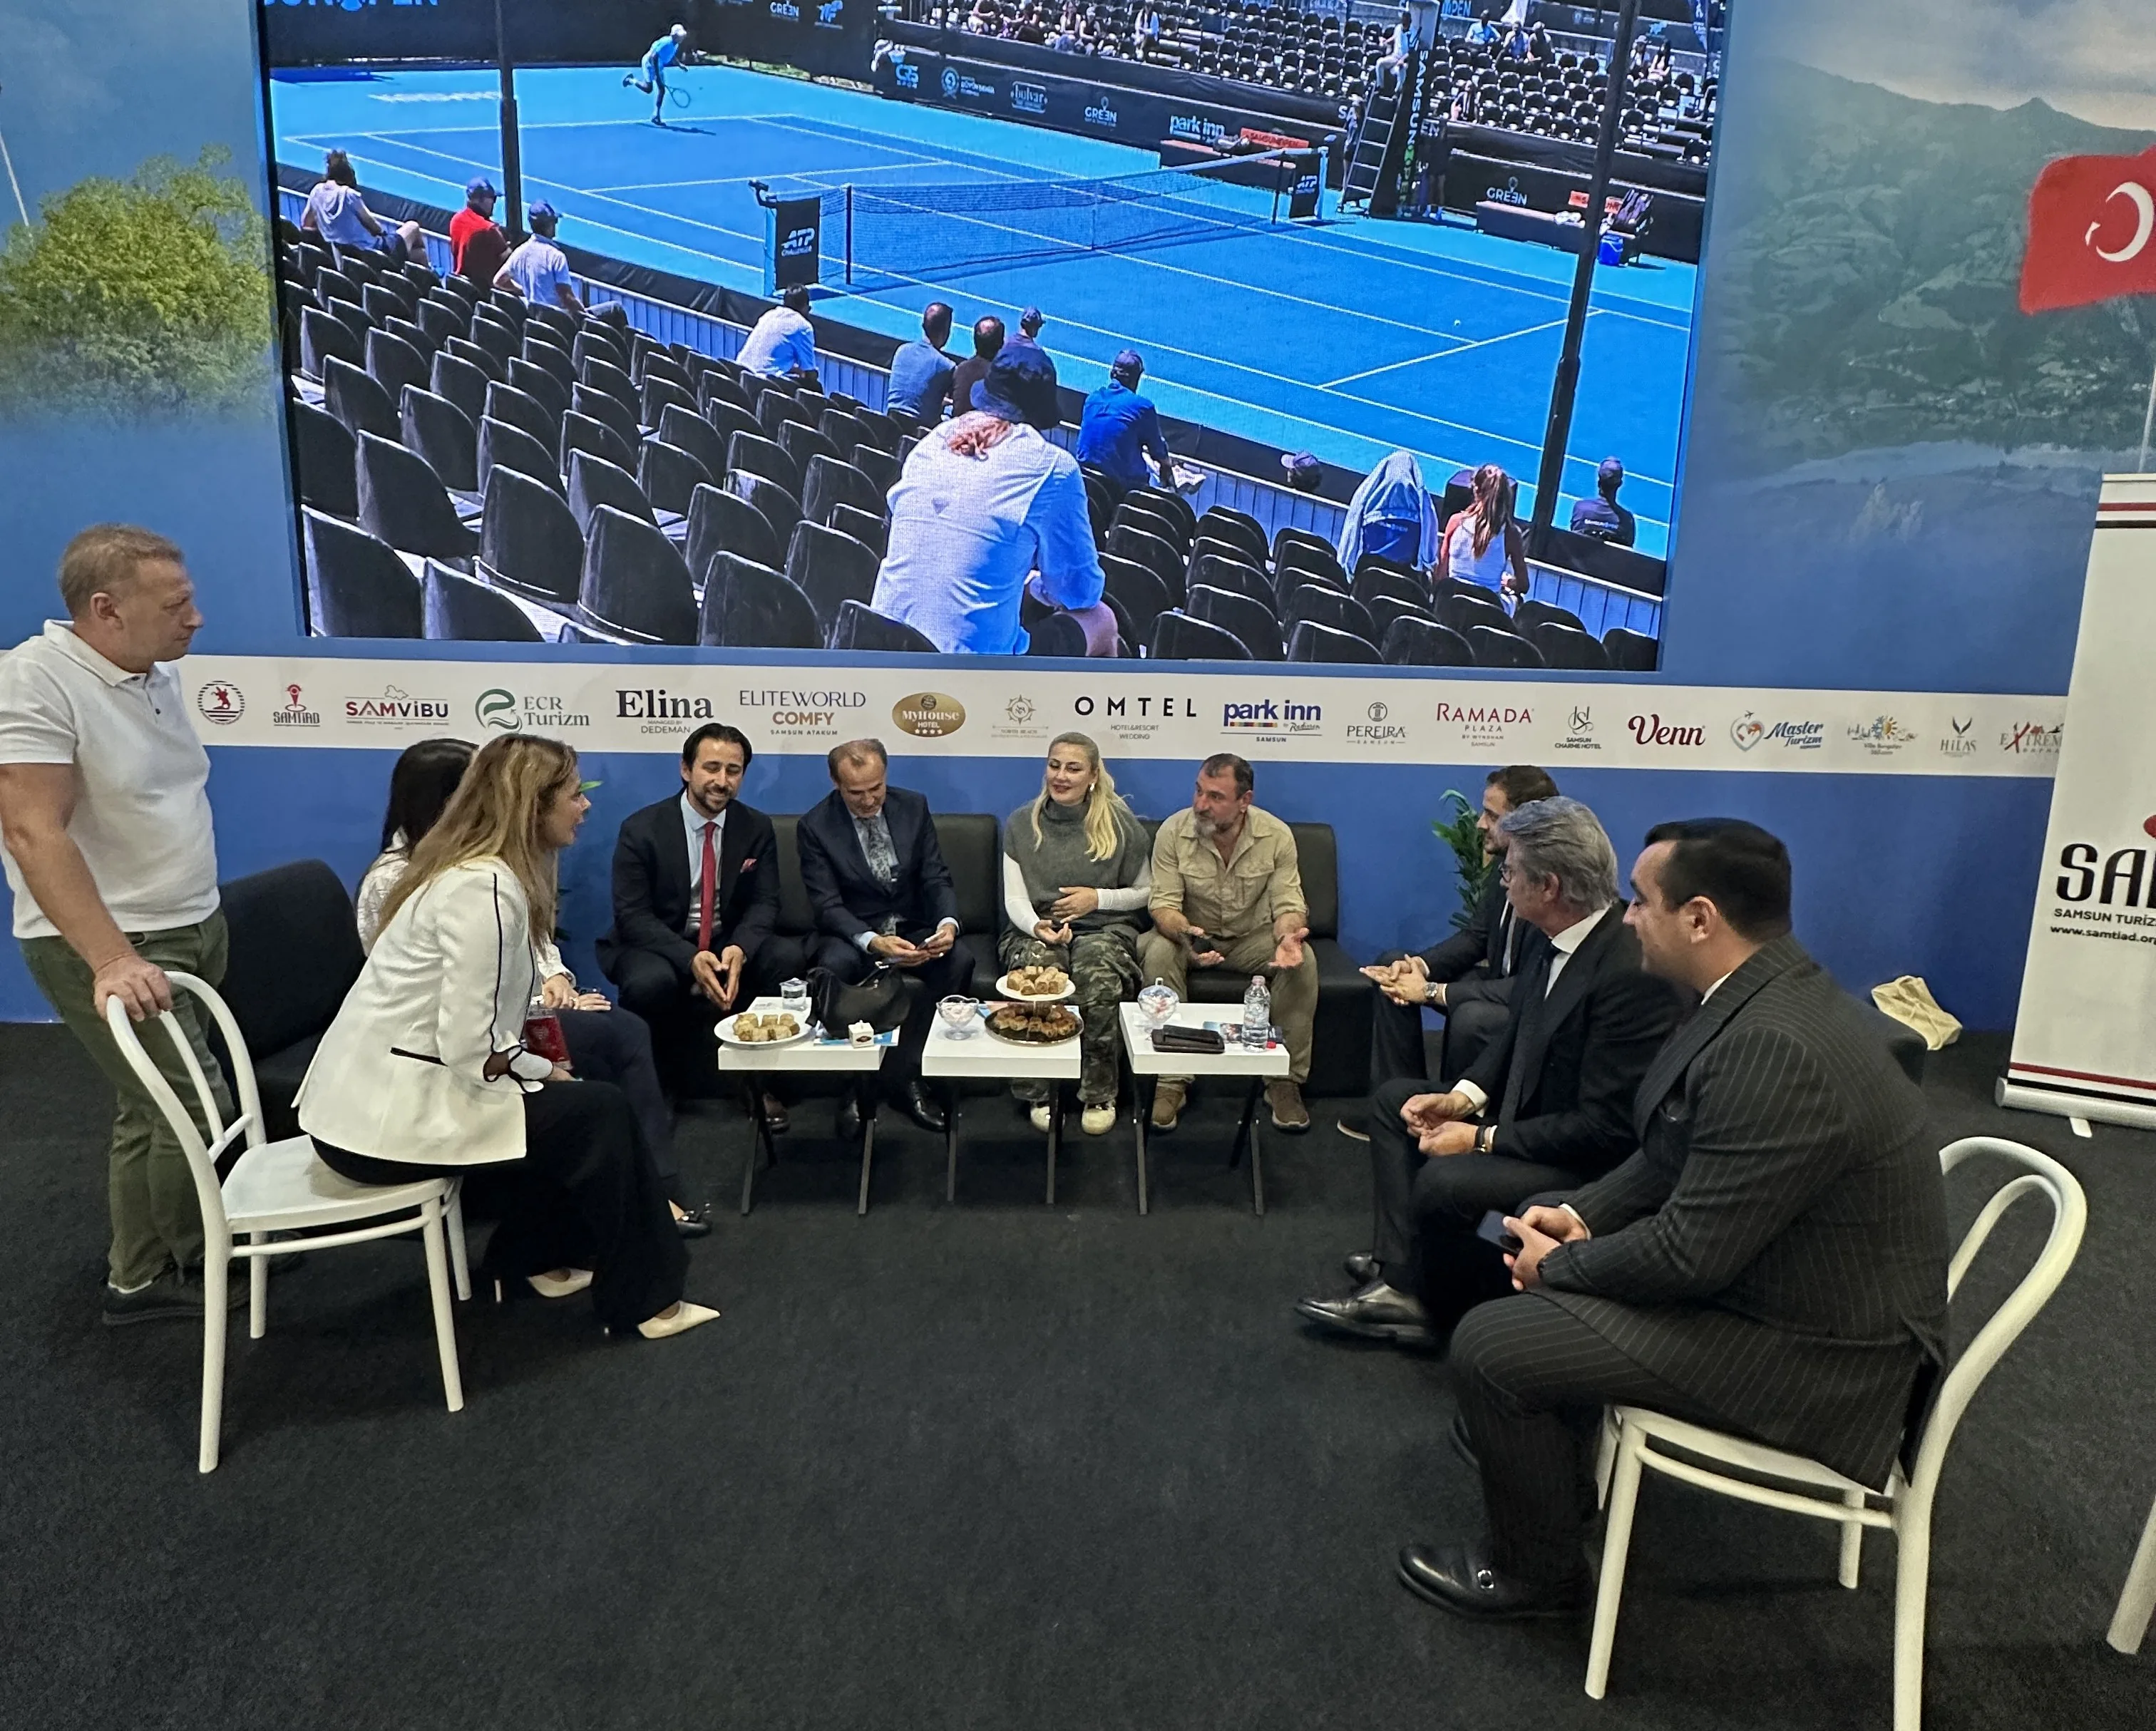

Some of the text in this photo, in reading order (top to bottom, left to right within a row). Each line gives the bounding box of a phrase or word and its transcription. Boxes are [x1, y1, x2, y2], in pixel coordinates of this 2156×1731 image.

[1084, 106, 1117, 123] GREEN
[1169, 115, 1201, 135] park
[1486, 187, 1528, 205] GREEN
[781, 227, 815, 249] ATP
[524, 697, 563, 710] ECR
[615, 689, 714, 719] Elina
[1074, 696, 1197, 717] OMTEL
[1223, 699, 1321, 726] park inn
[1437, 702, 1532, 724] RAMADA
[524, 712, 590, 726] Turizm
[772, 711, 834, 725] COMFY
[1347, 725, 1406, 739] PEREIRA
[1628, 714, 1706, 746] Venn
[1763, 721, 1824, 739] Master
[1784, 735, 1822, 747] Turizm
[2056, 843, 2156, 909] SA
[2054, 908, 2156, 927] SAMSUN TURİZ
